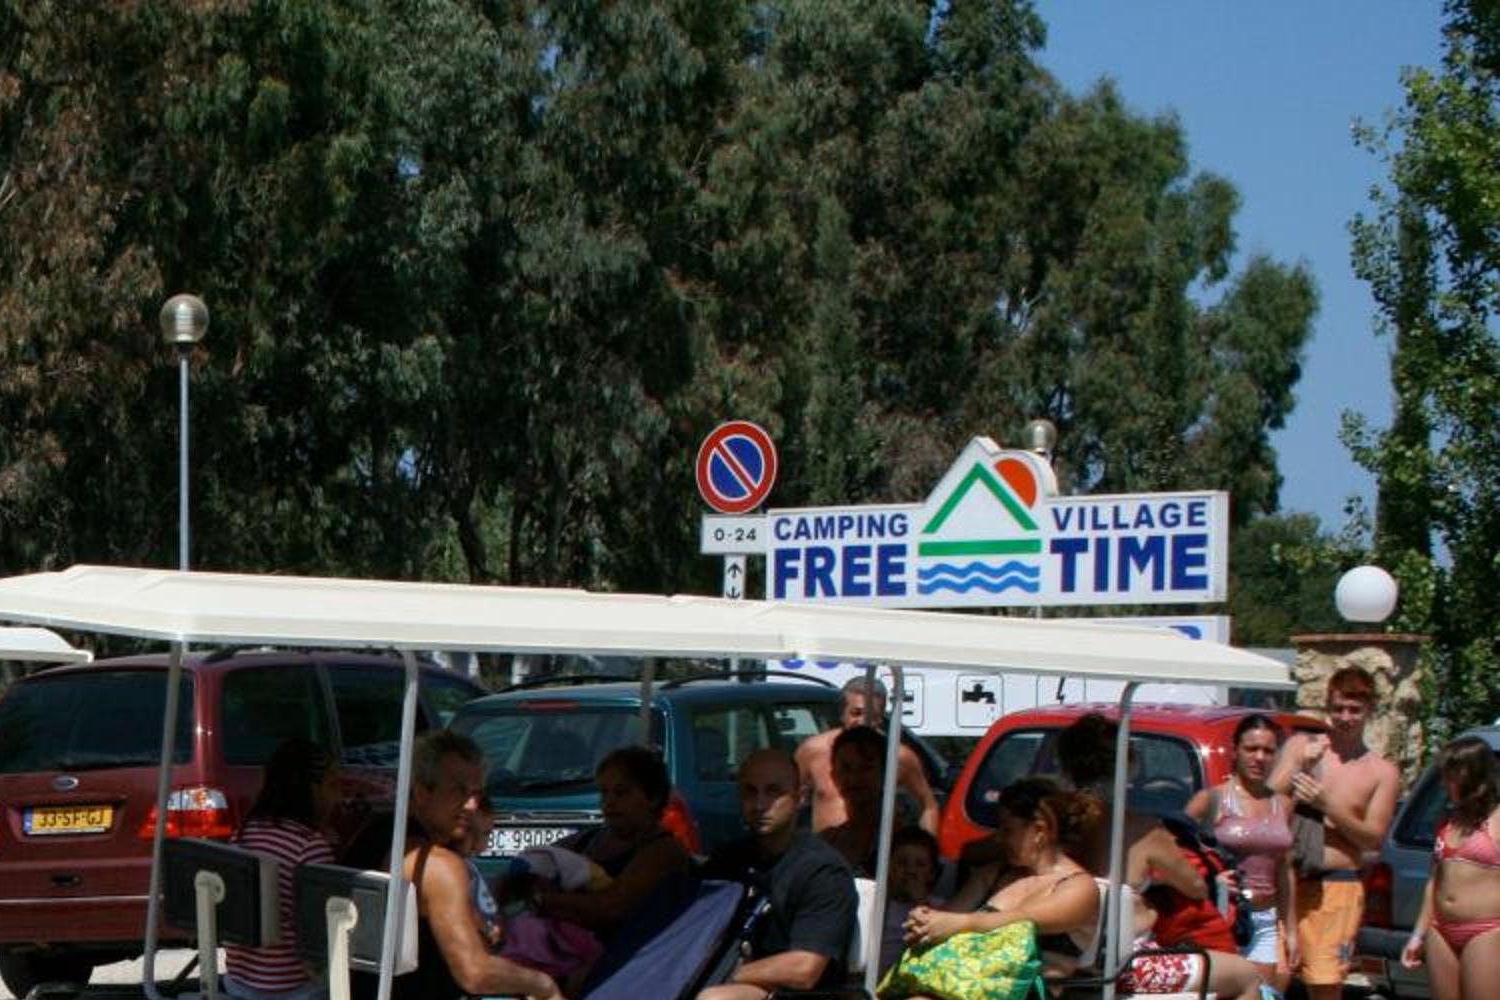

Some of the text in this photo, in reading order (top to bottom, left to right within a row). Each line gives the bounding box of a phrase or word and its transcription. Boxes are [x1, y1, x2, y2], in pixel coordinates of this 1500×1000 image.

[714, 528, 757, 542] 0-24
[774, 502, 1207, 541] CAMPING VILLAGE
[774, 533, 1208, 599] FREE TIME
